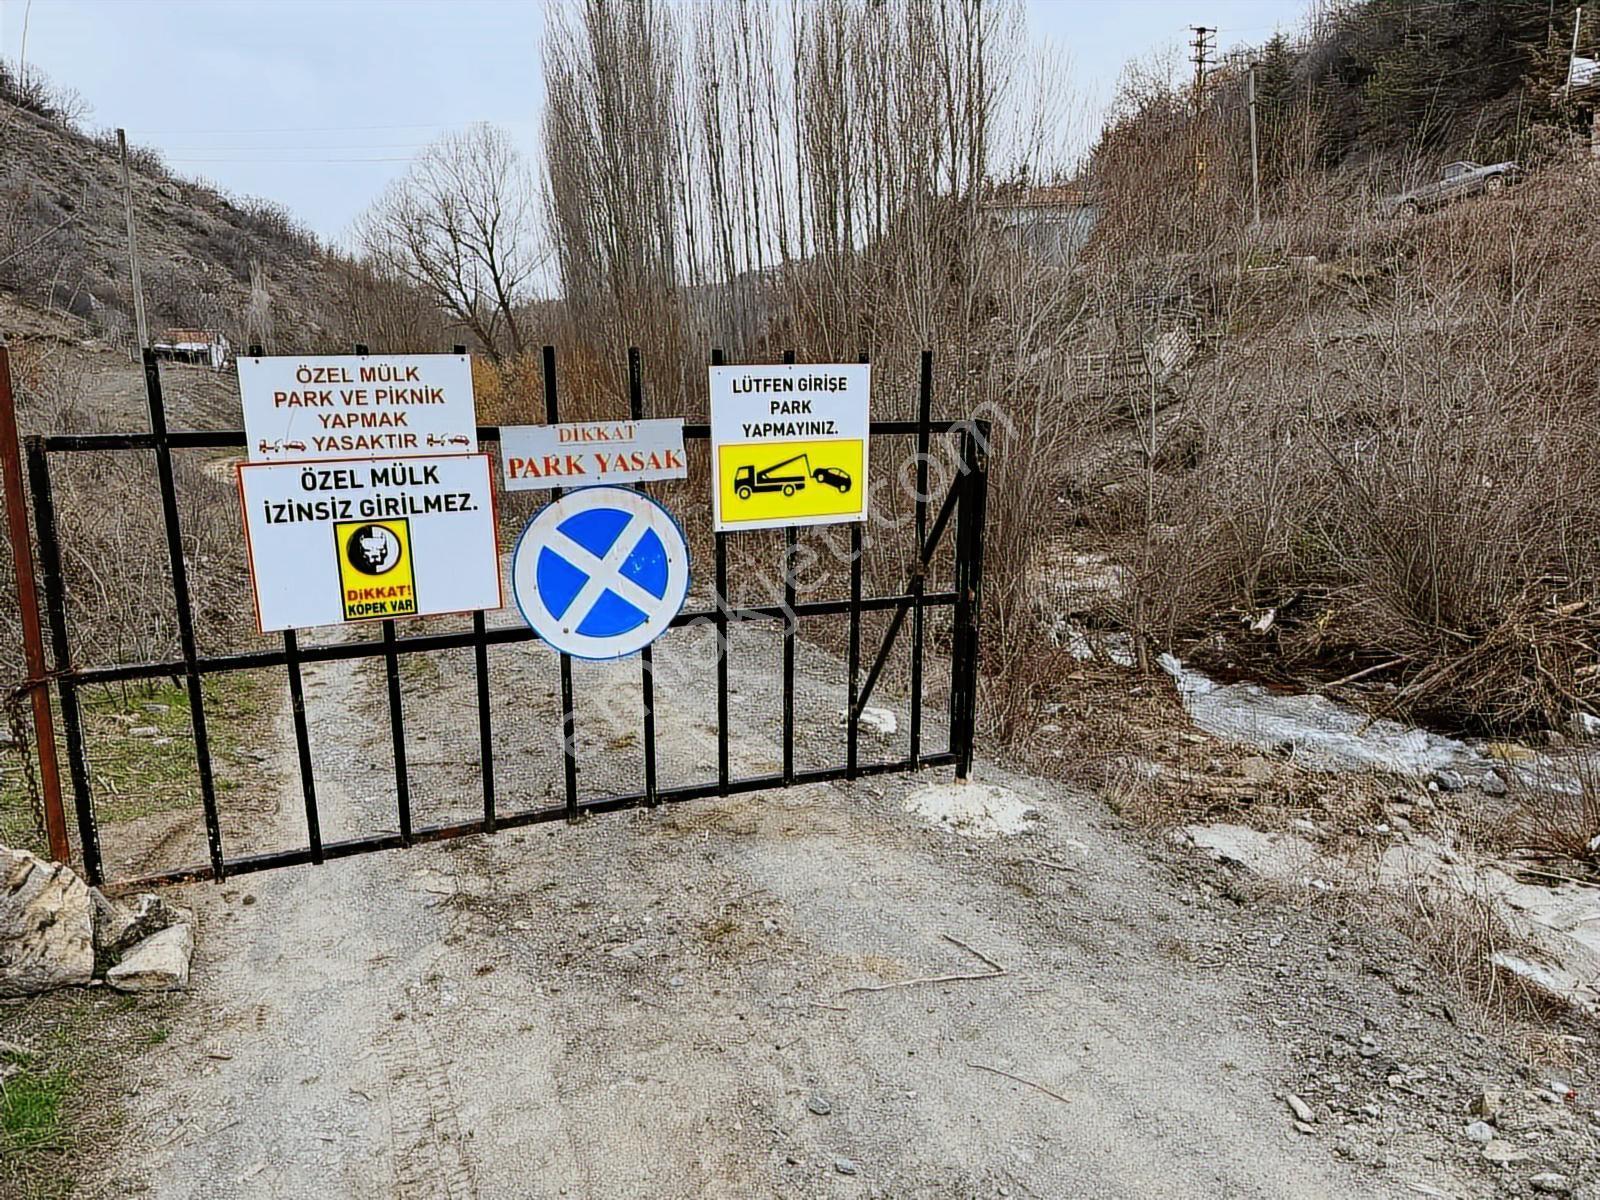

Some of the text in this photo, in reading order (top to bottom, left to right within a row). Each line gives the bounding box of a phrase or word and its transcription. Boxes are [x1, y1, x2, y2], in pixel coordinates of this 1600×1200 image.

[297, 364, 420, 384] ÖZEL MÜLK
[732, 373, 848, 394] LÜTFEN GİRİŞE
[274, 384, 445, 408] PARK VE PİKNİK
[770, 400, 812, 415] PARK
[318, 411, 408, 430] YAPMAK
[742, 421, 839, 438] YAPMAYINIZ.
[312, 433, 417, 452] YASAKTIR
[558, 423, 637, 443] DİKKAT
[508, 448, 684, 479] PARK YASAK
[301, 463, 440, 491] ÖZEL MÜLK
[264, 492, 479, 524] İZİNSİZ GİRİLMEZ.
[348, 599, 413, 617] KÖPEK VAR
